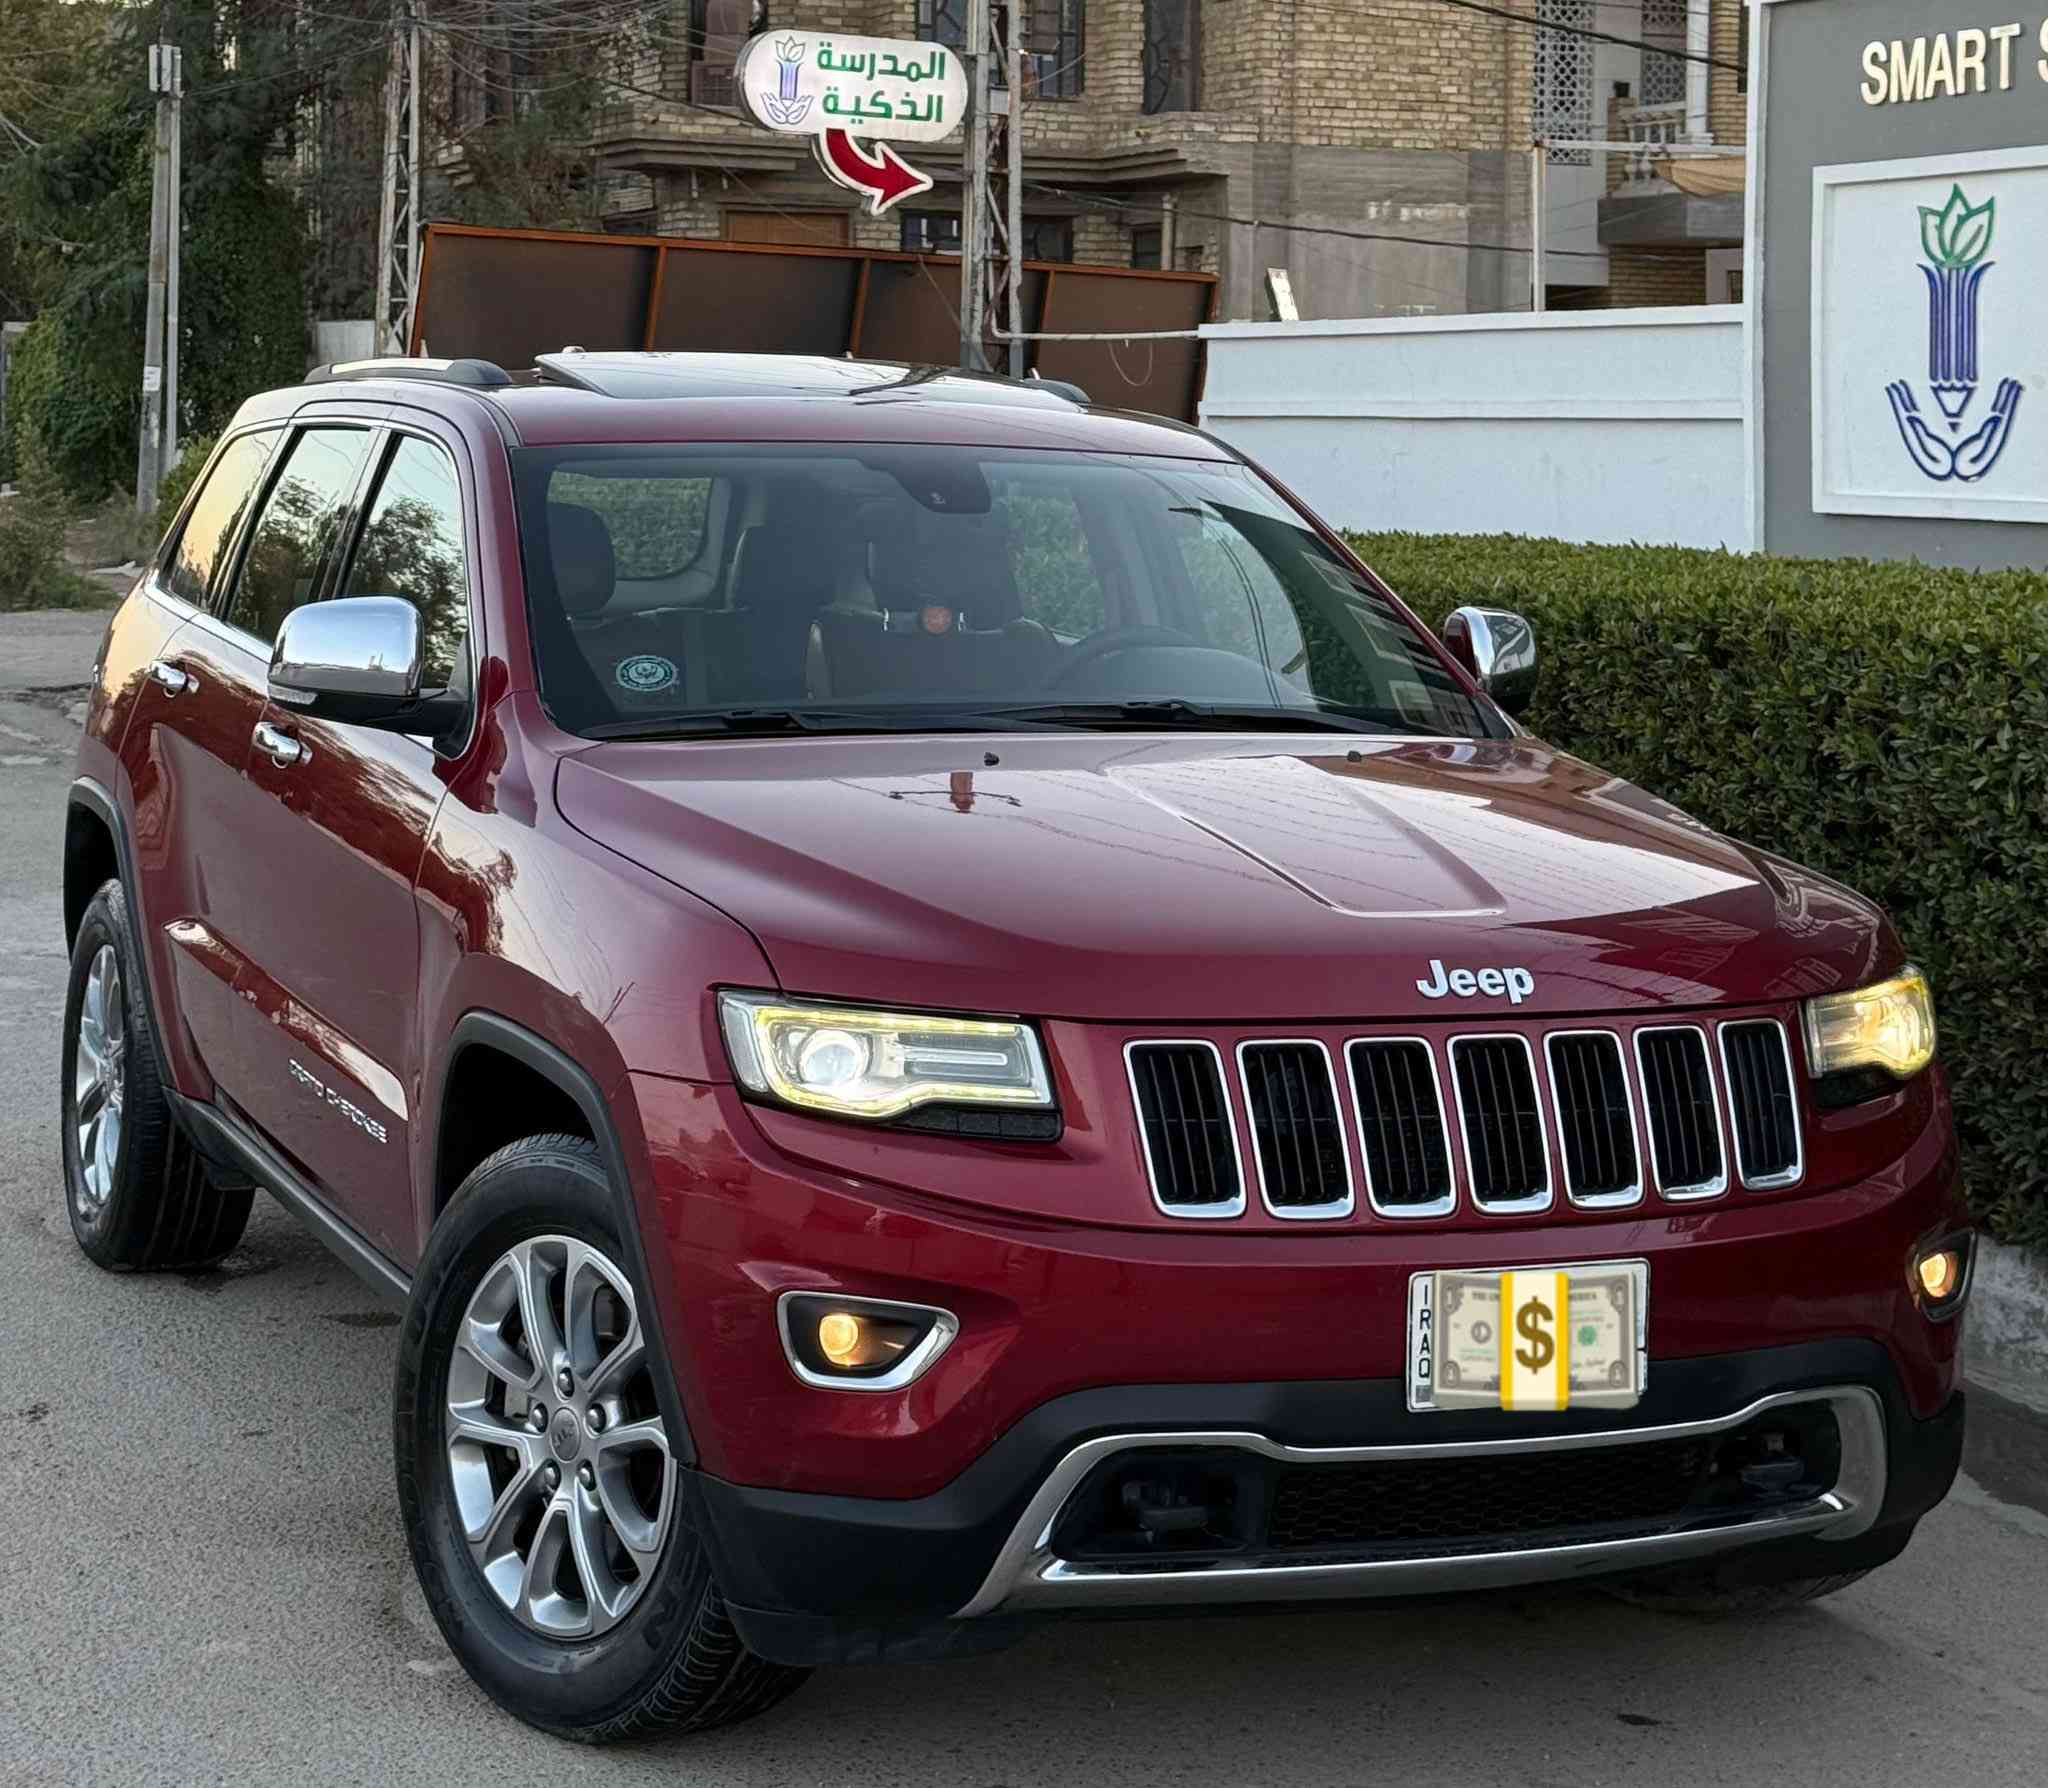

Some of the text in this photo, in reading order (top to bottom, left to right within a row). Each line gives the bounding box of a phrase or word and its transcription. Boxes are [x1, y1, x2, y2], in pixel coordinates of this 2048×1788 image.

[816, 41, 946, 82] المدرسة
[1860, 23, 2021, 105] SMART
[822, 86, 944, 124] الذكية
[1415, 959, 1535, 1005] Jeep
[1418, 1284, 1432, 1379] IRAQ
